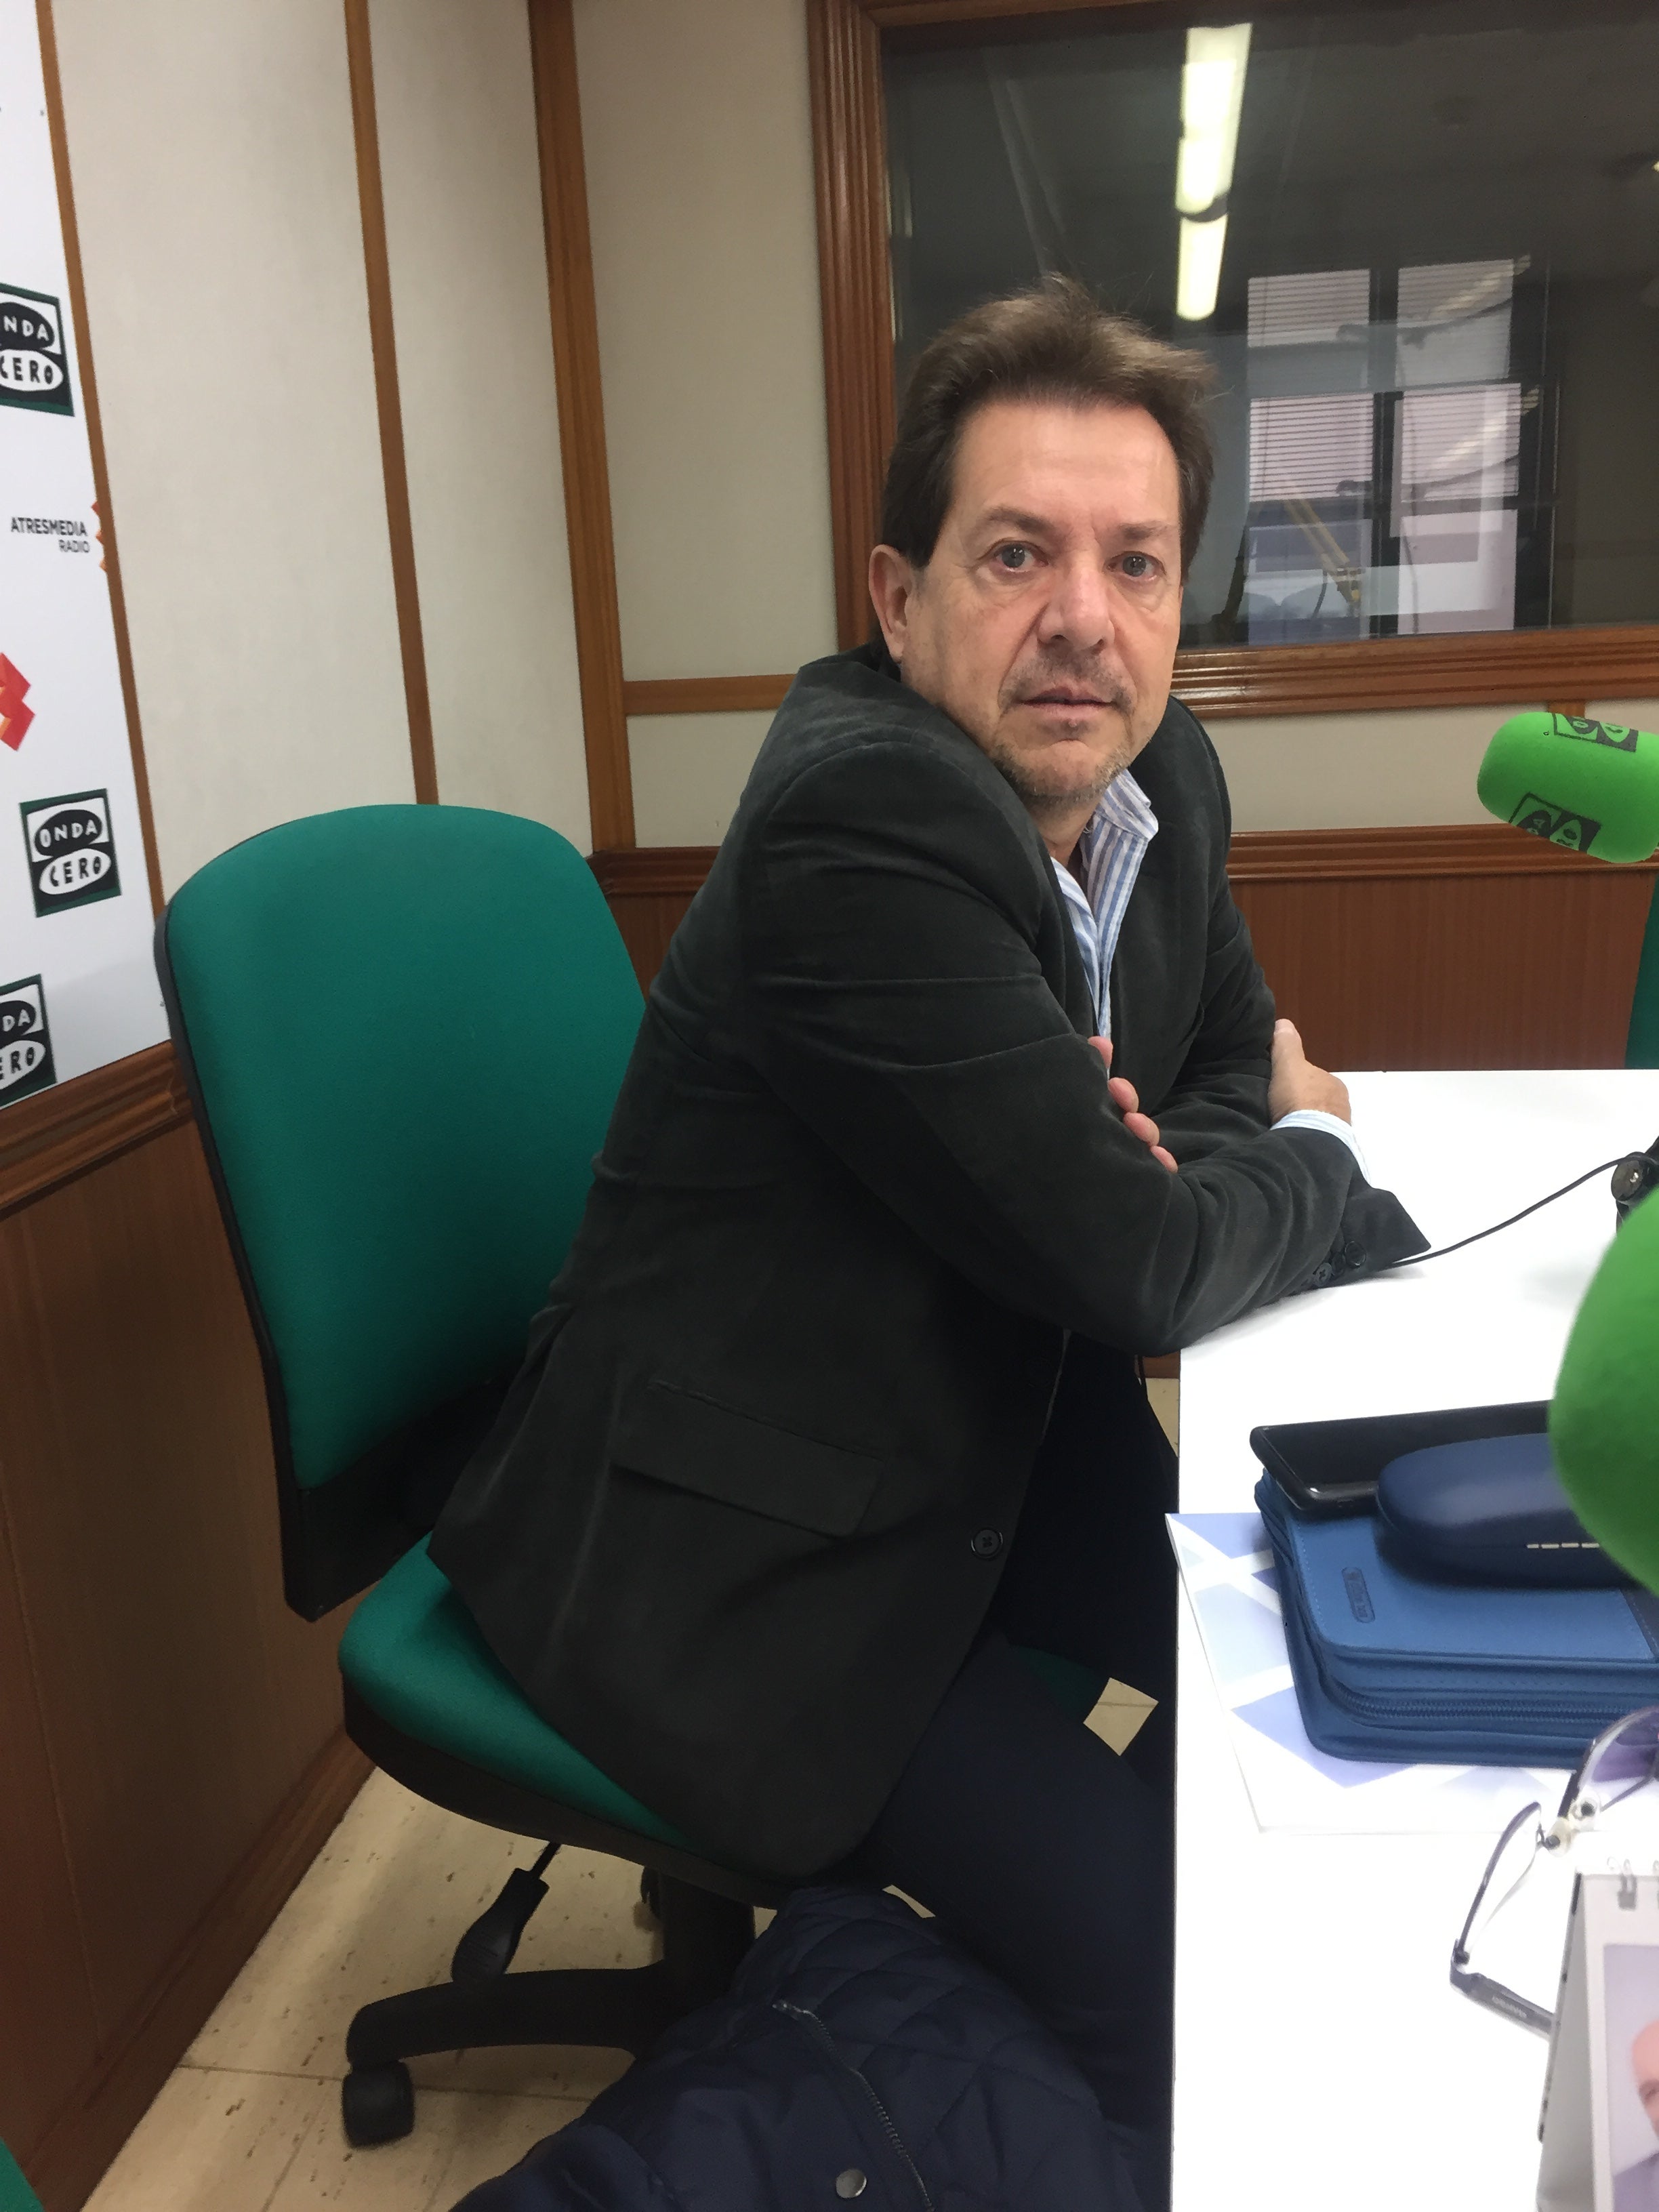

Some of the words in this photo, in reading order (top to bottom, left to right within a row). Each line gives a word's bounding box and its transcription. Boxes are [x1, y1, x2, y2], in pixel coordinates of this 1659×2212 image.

[11, 516, 87, 536] ATRESMEDIA
[58, 539, 90, 553] RADIO
[39, 819, 98, 848] ONDA
[49, 856, 102, 887] CERO
